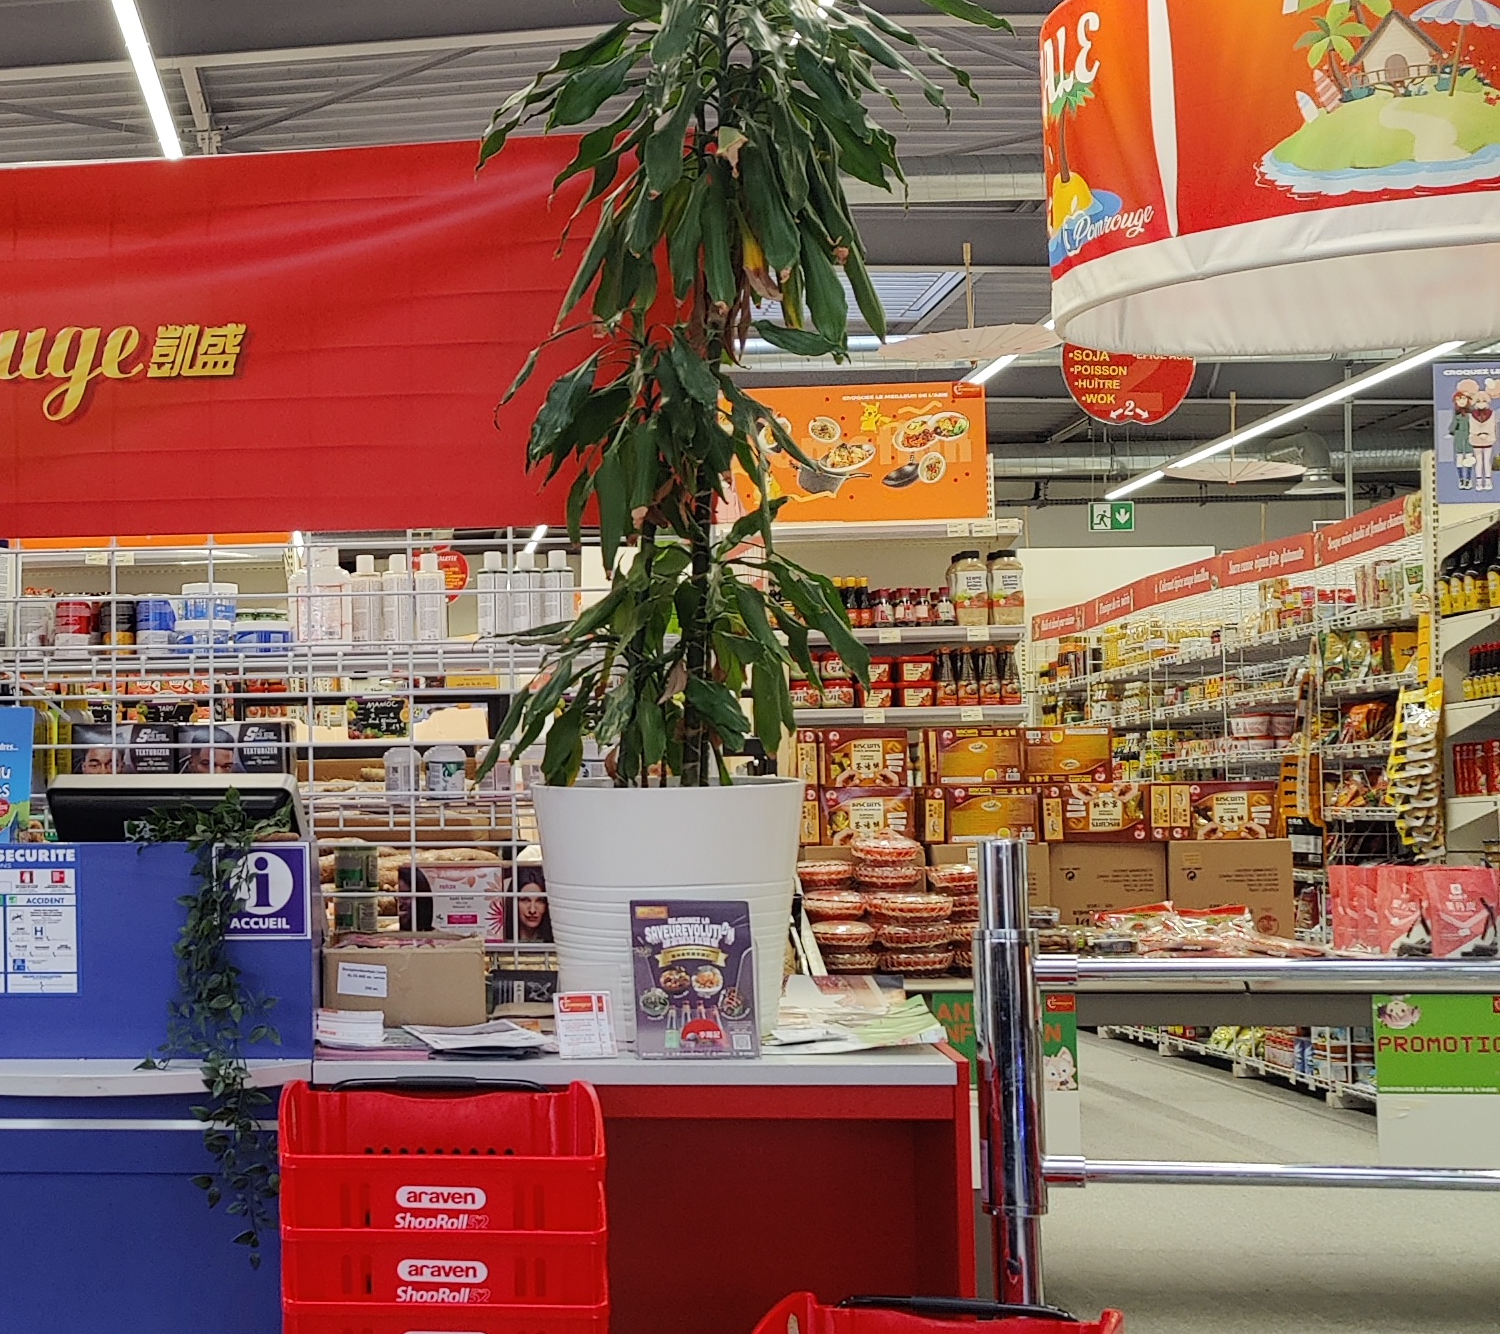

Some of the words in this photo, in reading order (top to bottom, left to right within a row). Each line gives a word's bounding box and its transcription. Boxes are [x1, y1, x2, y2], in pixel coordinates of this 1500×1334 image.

[1073, 350, 1110, 361] SOJA
[1074, 365, 1127, 376] POISSON
[1078, 377, 1120, 389] HUÎTRE
[1085, 394, 1116, 404] WOK
[1124, 400, 1135, 416] 2
[26, 897, 65, 905] ACCIDENT
[230, 917, 290, 930] ACCUEIL
[407, 1189, 476, 1205] araven
[408, 1263, 477, 1278] araven
